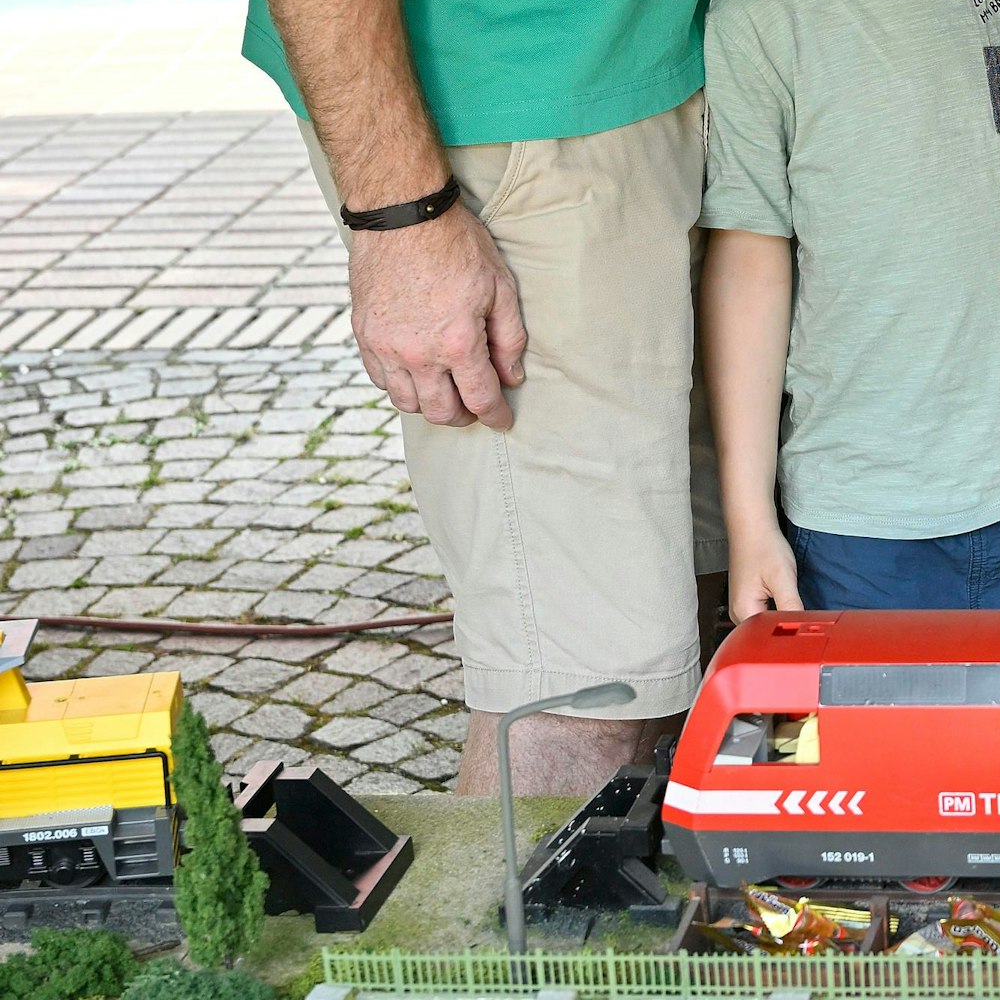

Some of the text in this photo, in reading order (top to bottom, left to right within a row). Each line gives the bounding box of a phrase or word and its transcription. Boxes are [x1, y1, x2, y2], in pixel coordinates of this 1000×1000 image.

[979, 8, 993, 24] MY
[943, 796, 971, 811] PM
[22, 828, 78, 842] 1802.006
[820, 852, 875, 863] 152 019-1
